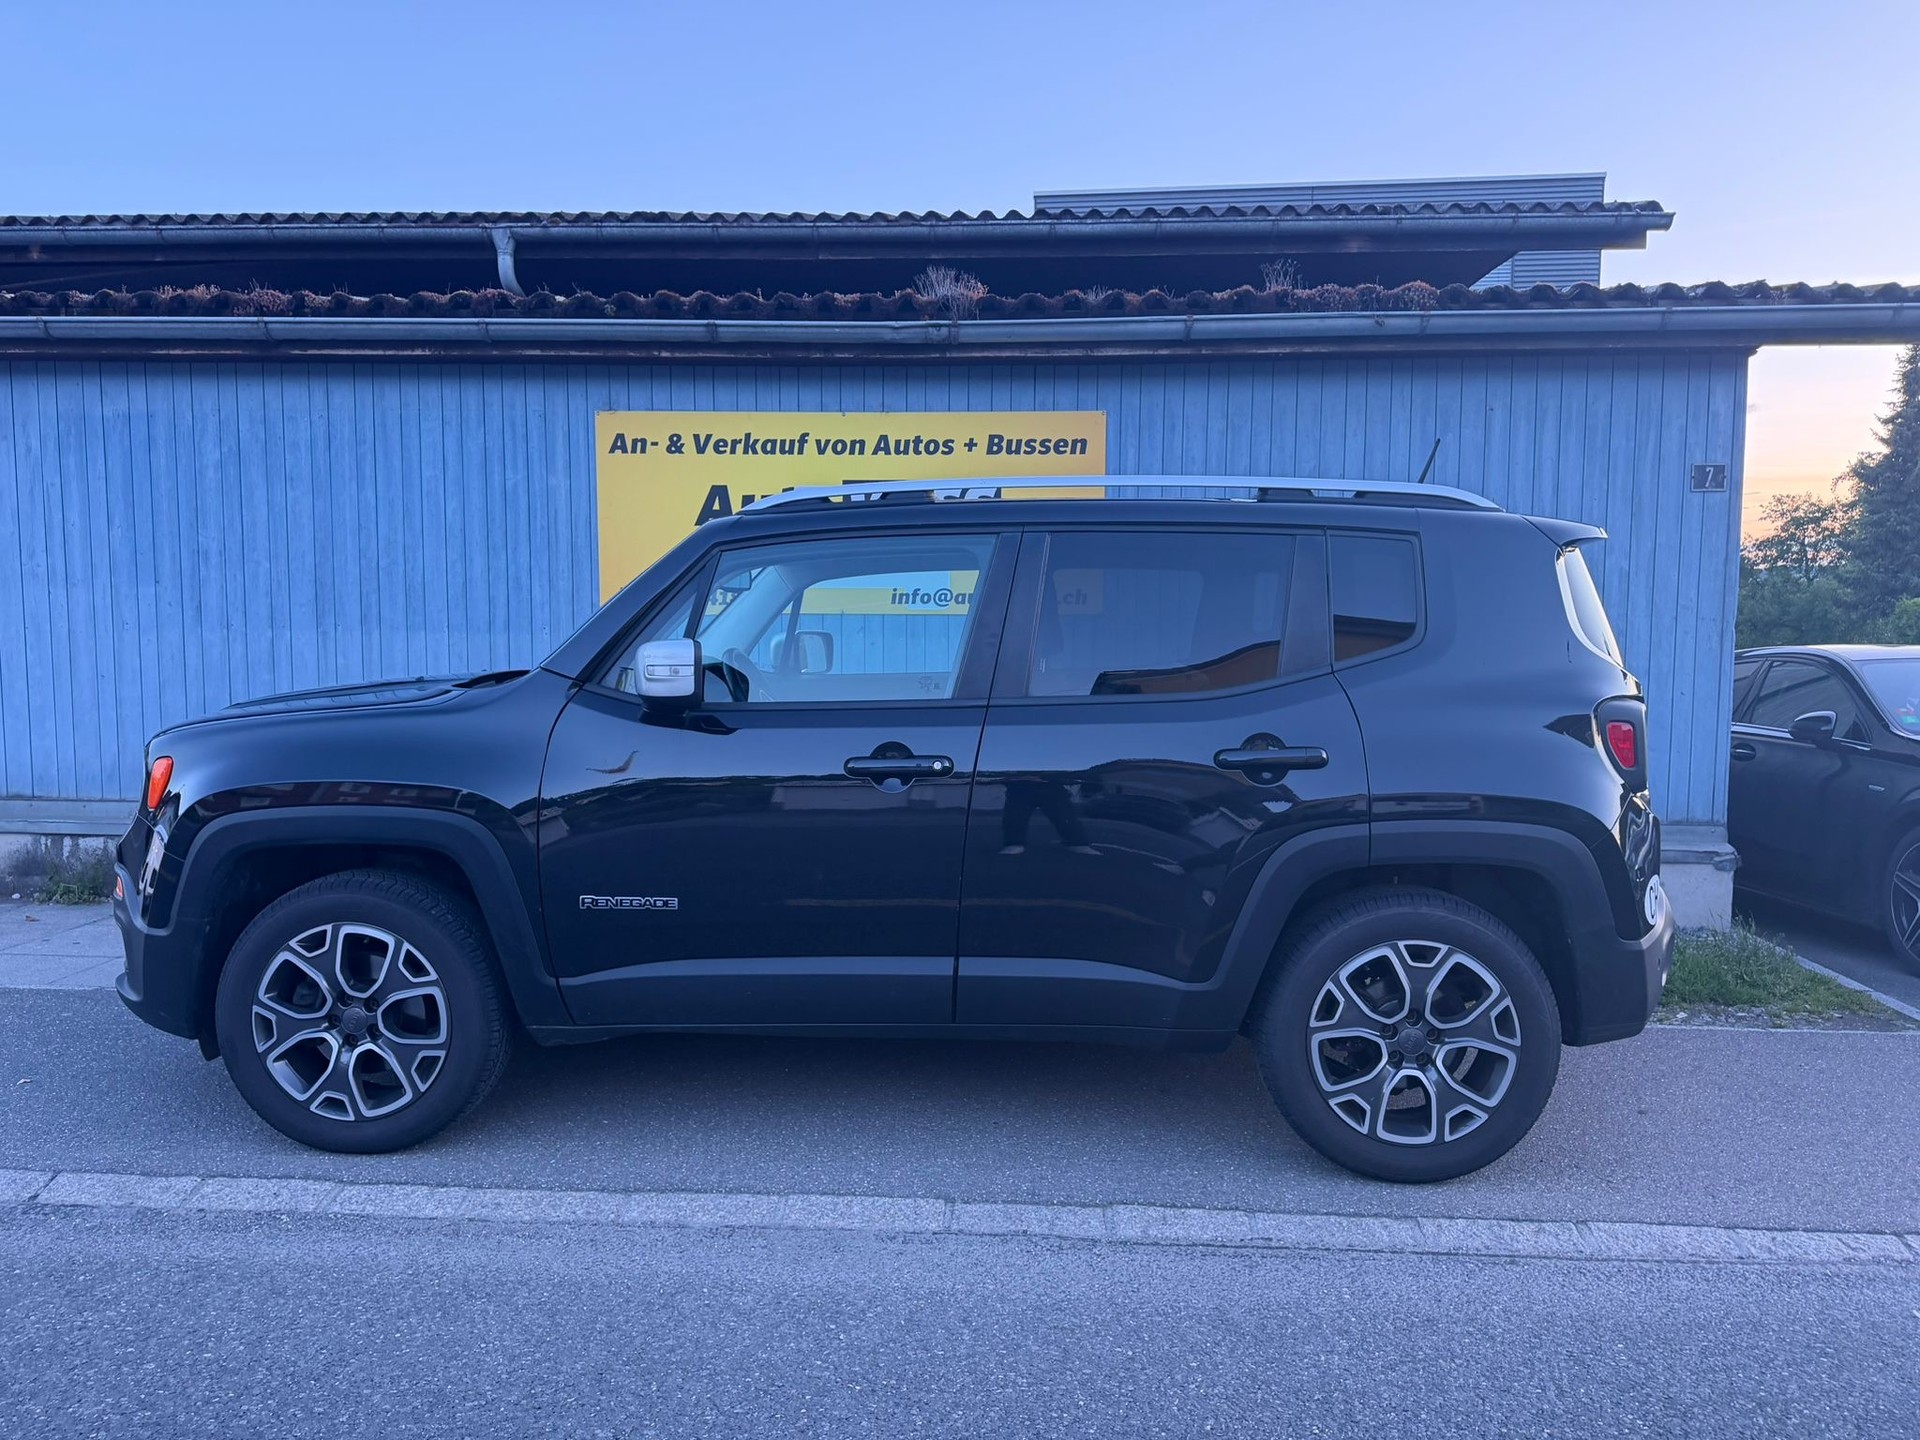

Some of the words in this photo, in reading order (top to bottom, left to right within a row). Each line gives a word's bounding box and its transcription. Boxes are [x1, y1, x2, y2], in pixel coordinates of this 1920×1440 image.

[608, 433, 659, 454] An-
[665, 433, 686, 455] &
[692, 432, 810, 455] Verkauf
[815, 438, 867, 456] von
[871, 434, 956, 456] Autos
[963, 438, 978, 453] +
[986, 434, 1088, 456] Bussen
[1705, 466, 1714, 488] 7
[579, 895, 679, 910] RENEGADE
